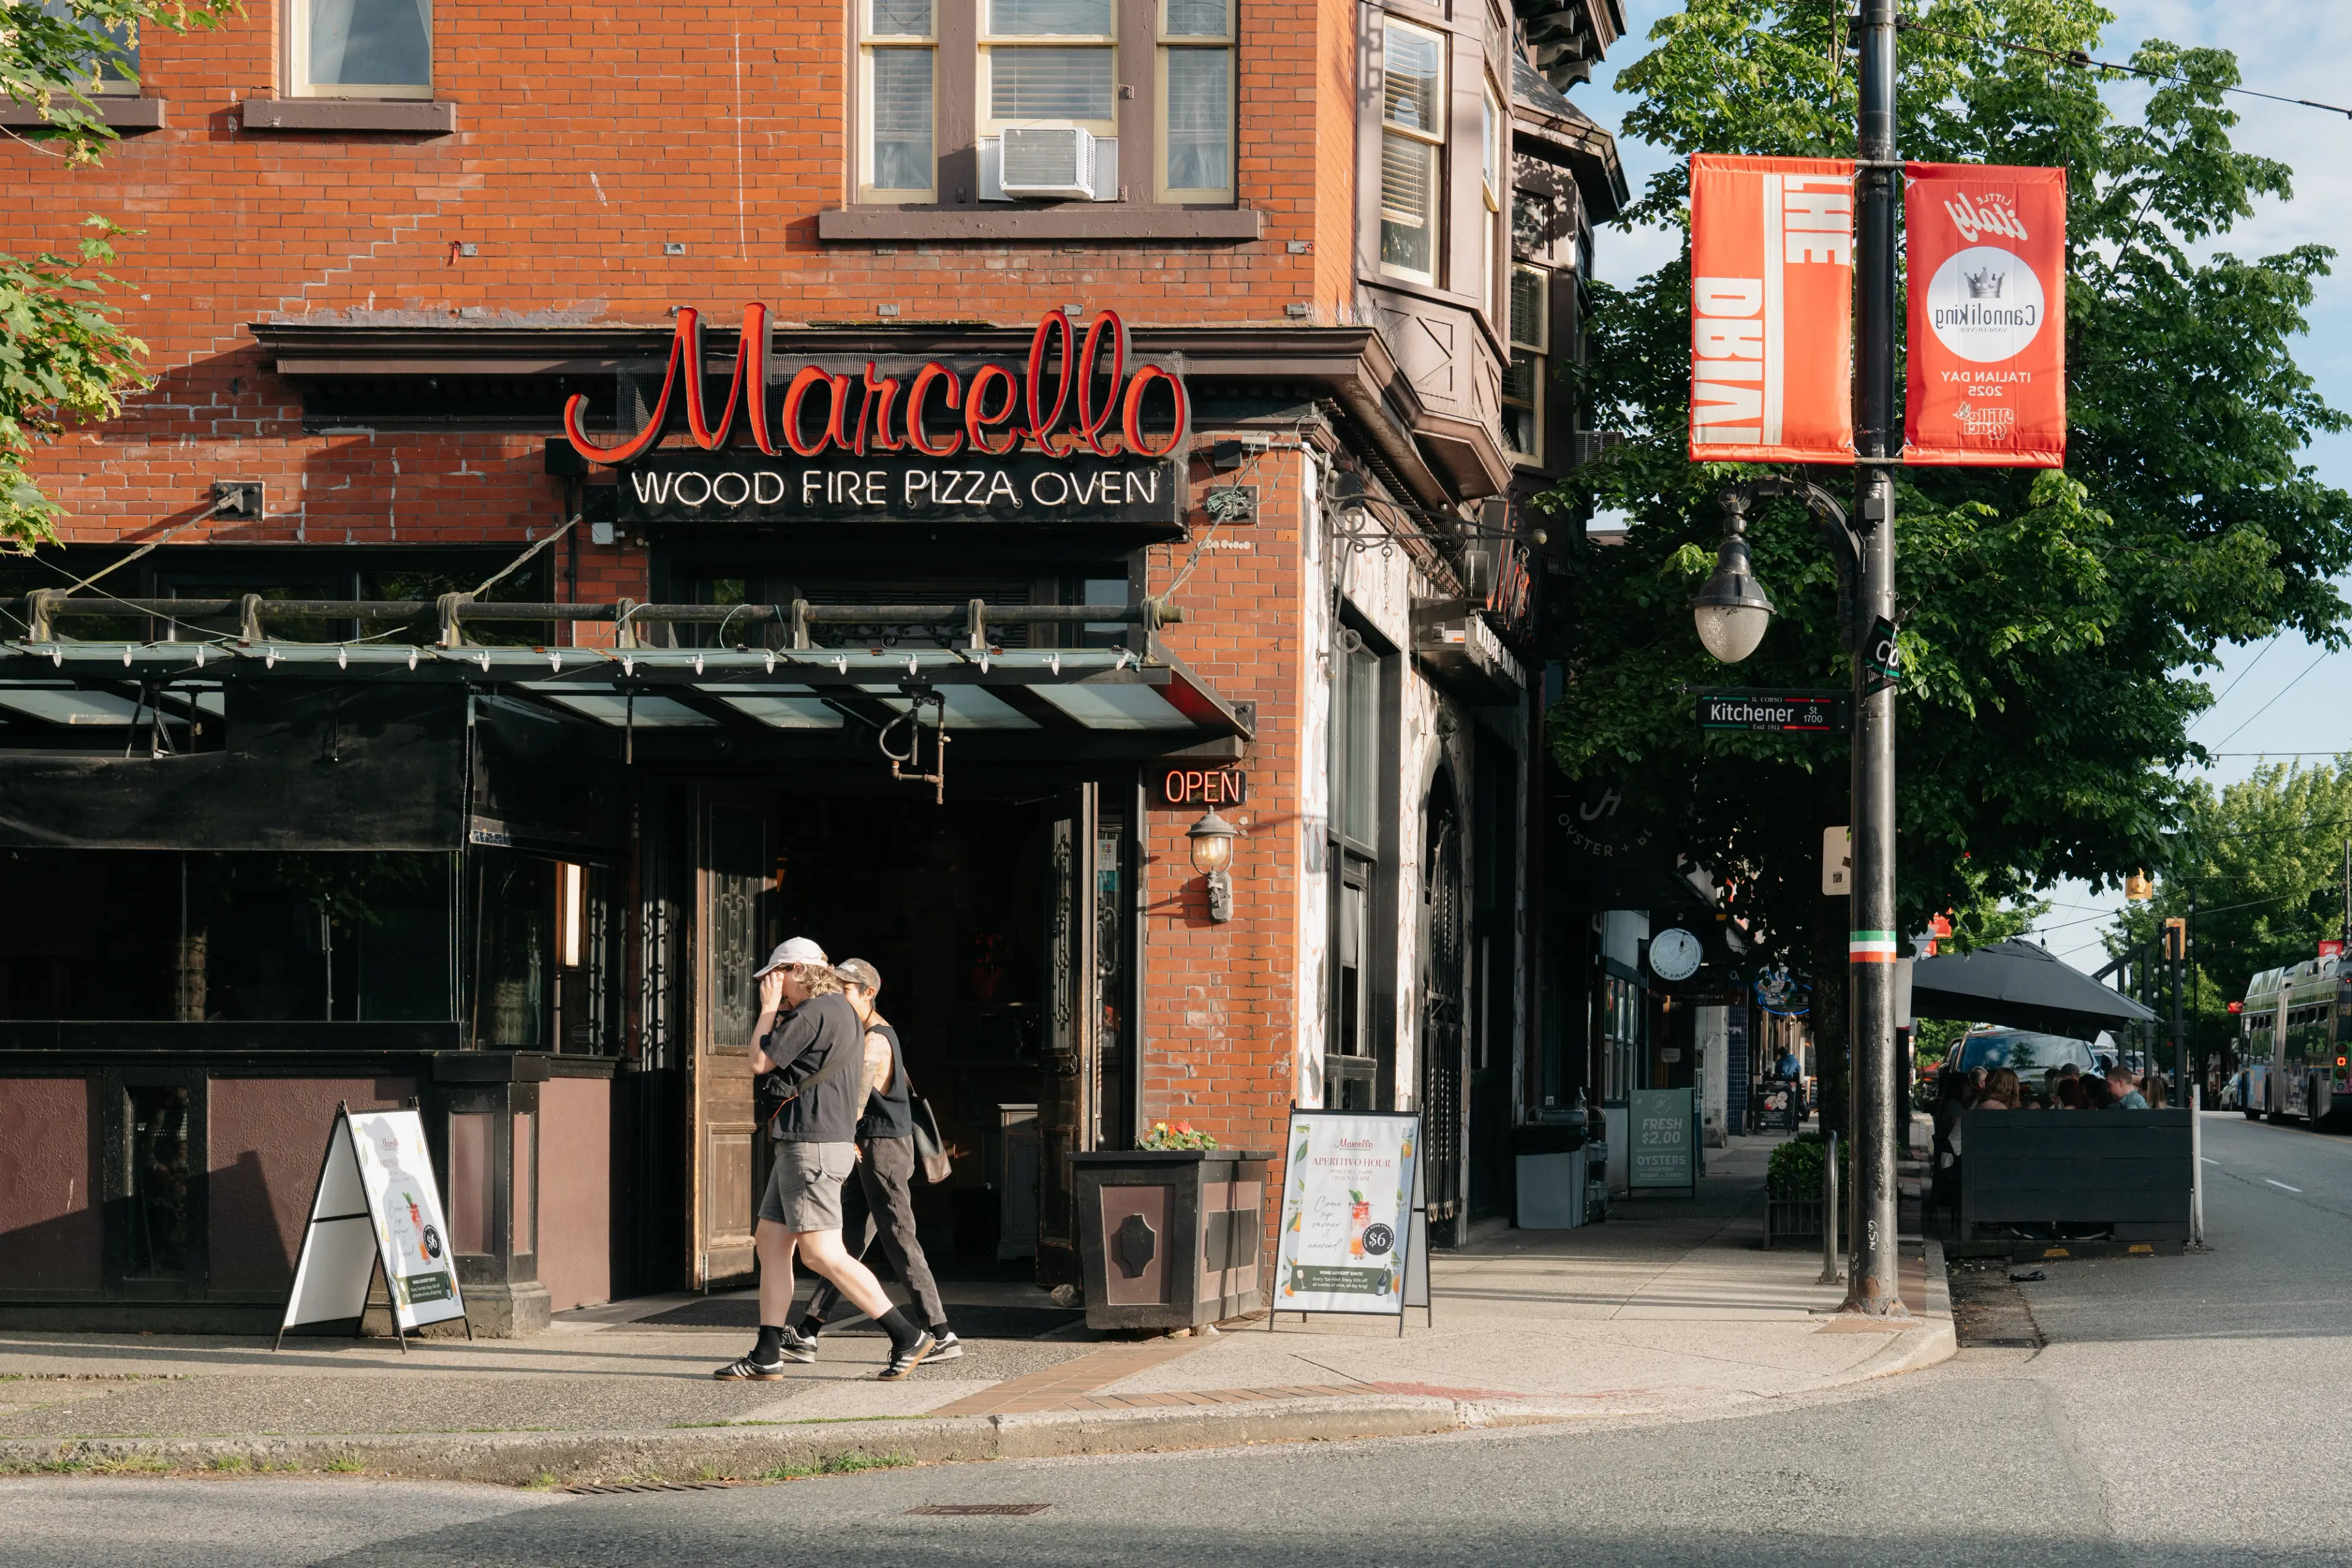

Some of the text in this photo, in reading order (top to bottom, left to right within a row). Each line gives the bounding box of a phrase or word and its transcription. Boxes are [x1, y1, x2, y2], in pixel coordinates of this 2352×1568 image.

[564, 302, 1188, 464] Marcello
[631, 470, 1158, 506] WOOD FIRE PIZZA OVEN
[1711, 703, 1794, 722] Kitchener
[1803, 715, 1823, 723] 1700
[1165, 770, 1240, 803] OPEN
[1558, 813, 1613, 857] OYSTER
[1653, 959, 1697, 978] VIET FAMILY
[1642, 1118, 1683, 1130] FRESH
[1334, 1138, 1373, 1149] Marcello
[1642, 1131, 1681, 1144] $2.00
[1313, 1157, 1391, 1167] APERITIVO HOUR
[1637, 1155, 1686, 1166] OYSTERS
[1314, 1195, 1343, 1212] Come
[426, 1234, 437, 1251] $6
[1369, 1231, 1386, 1248] $6
